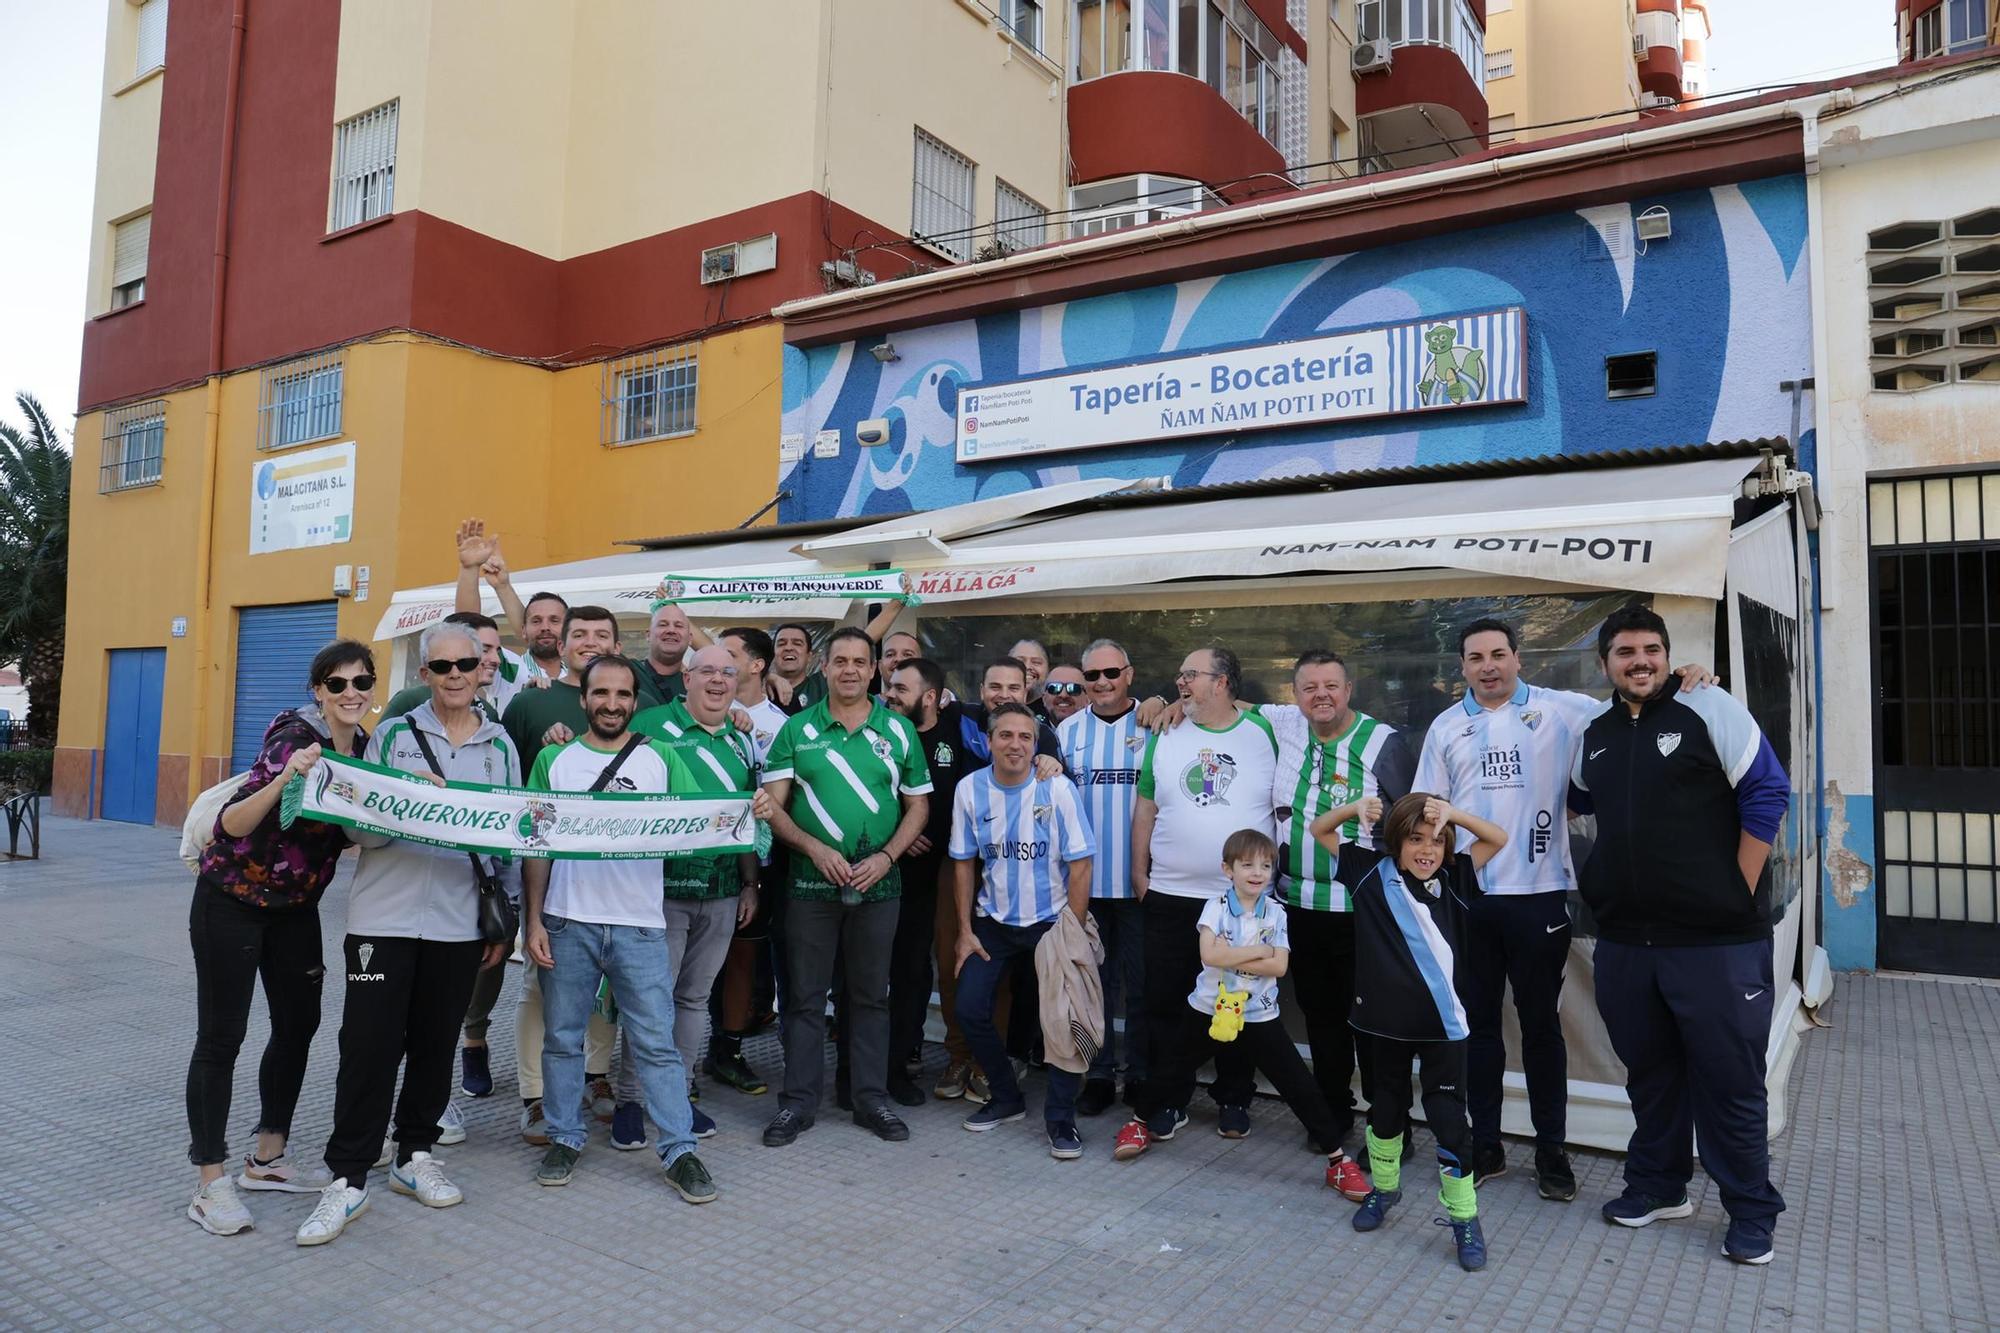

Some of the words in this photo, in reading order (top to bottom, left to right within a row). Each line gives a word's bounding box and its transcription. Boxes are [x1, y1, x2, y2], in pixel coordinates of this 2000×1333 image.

[1070, 372, 1181, 415] Tapería
[1211, 346, 1373, 394] Bocatería
[1161, 408, 1204, 429] ÑAM
[1211, 402, 1257, 424] ÑAM
[1264, 394, 1314, 417] POTI
[1322, 387, 1374, 410] POTI
[278, 481, 329, 499] MALACITANA
[331, 475, 347, 489] S.L.
[323, 498, 330, 508] 12
[1260, 538, 1436, 556] NAM-NAM
[1454, 538, 1652, 563] POTI-POTI
[615, 591, 657, 599] TAPE
[698, 582, 769, 594] CALIFATO
[774, 579, 884, 592] BLANQUIVERDE
[1481, 761, 1522, 781] laga
[362, 791, 511, 831] BOQUERONES
[355, 821, 369, 830] Iré
[370, 825, 401, 837] contigo
[403, 833, 427, 843] hasta
[556, 816, 709, 840] BLANQUIVERDES
[1536, 810, 1552, 854] Olin
[614, 851, 644, 859] contigo
[1002, 840, 1047, 861] UNESCO
